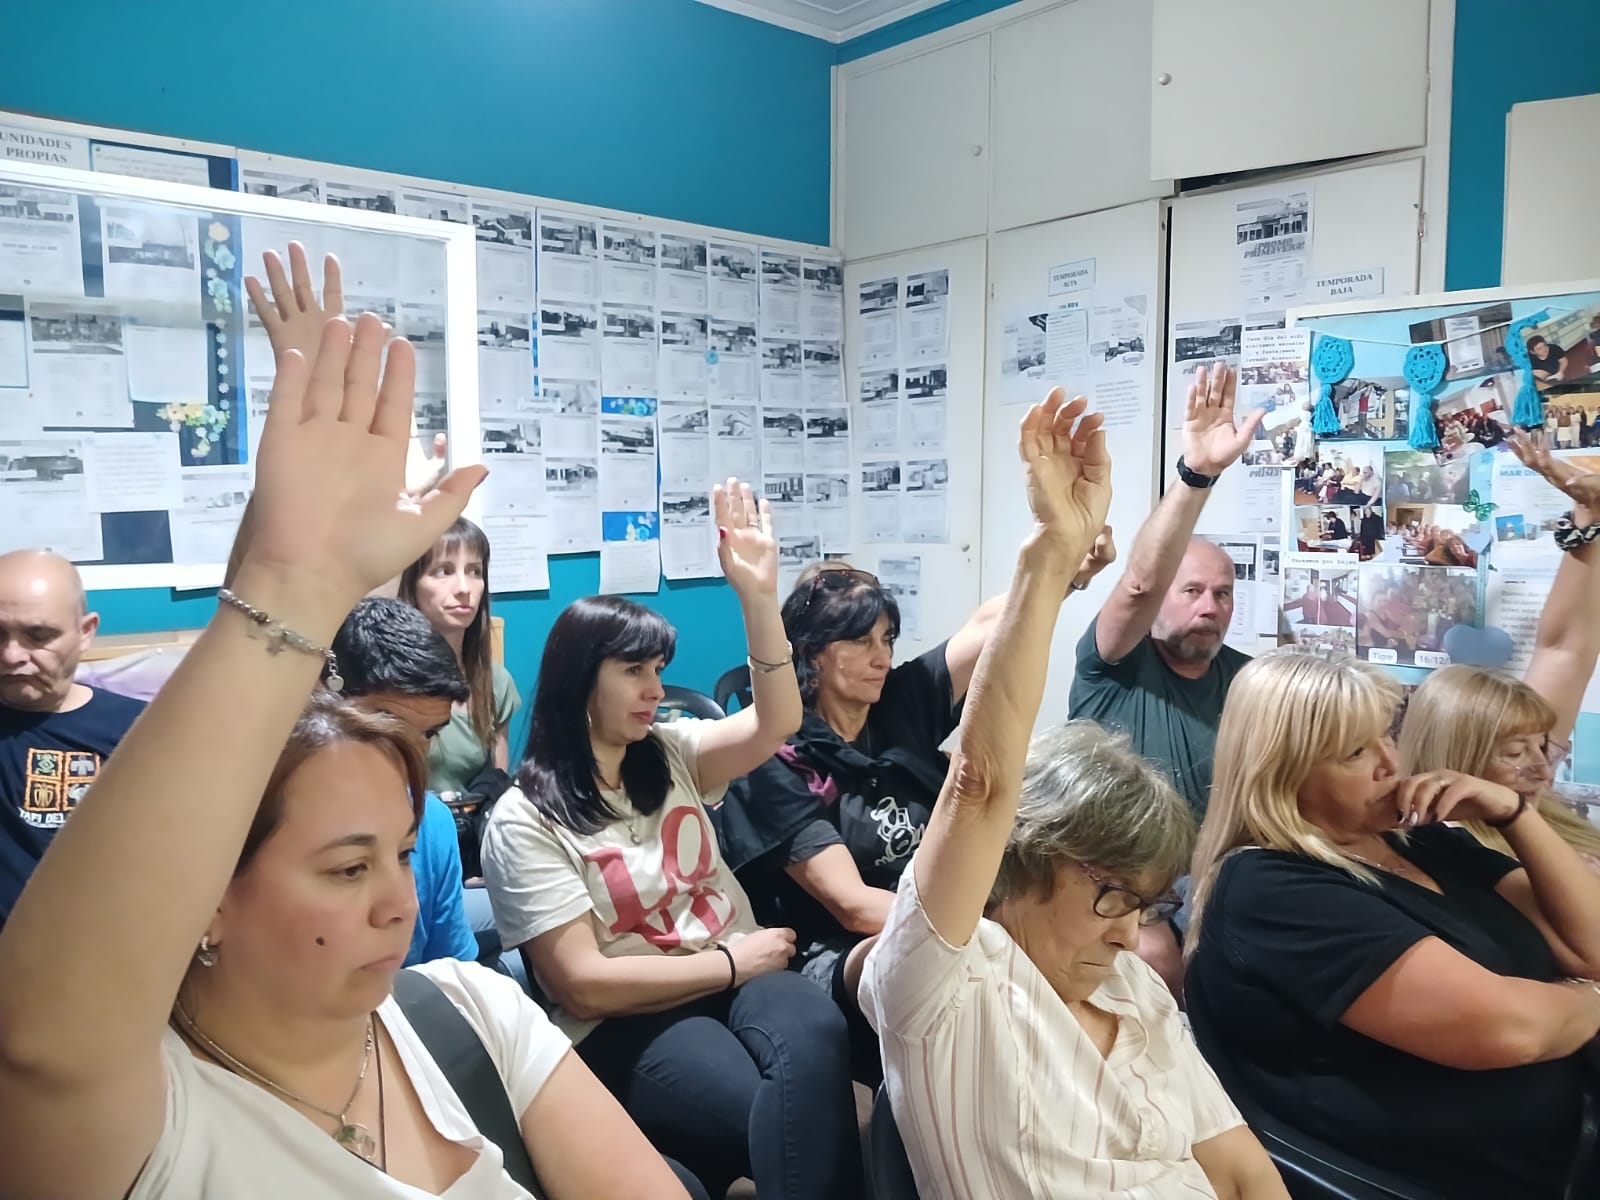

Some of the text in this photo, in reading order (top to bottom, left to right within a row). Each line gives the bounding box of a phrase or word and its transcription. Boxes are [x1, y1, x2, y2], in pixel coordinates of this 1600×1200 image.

[6, 147, 68, 163] PROPIAS
[1053, 269, 1088, 281] TEMPORADA
[1317, 274, 1373, 288] TEMPORADA
[1330, 287, 1353, 296] BAJA
[1500, 469, 1522, 477] MAR
